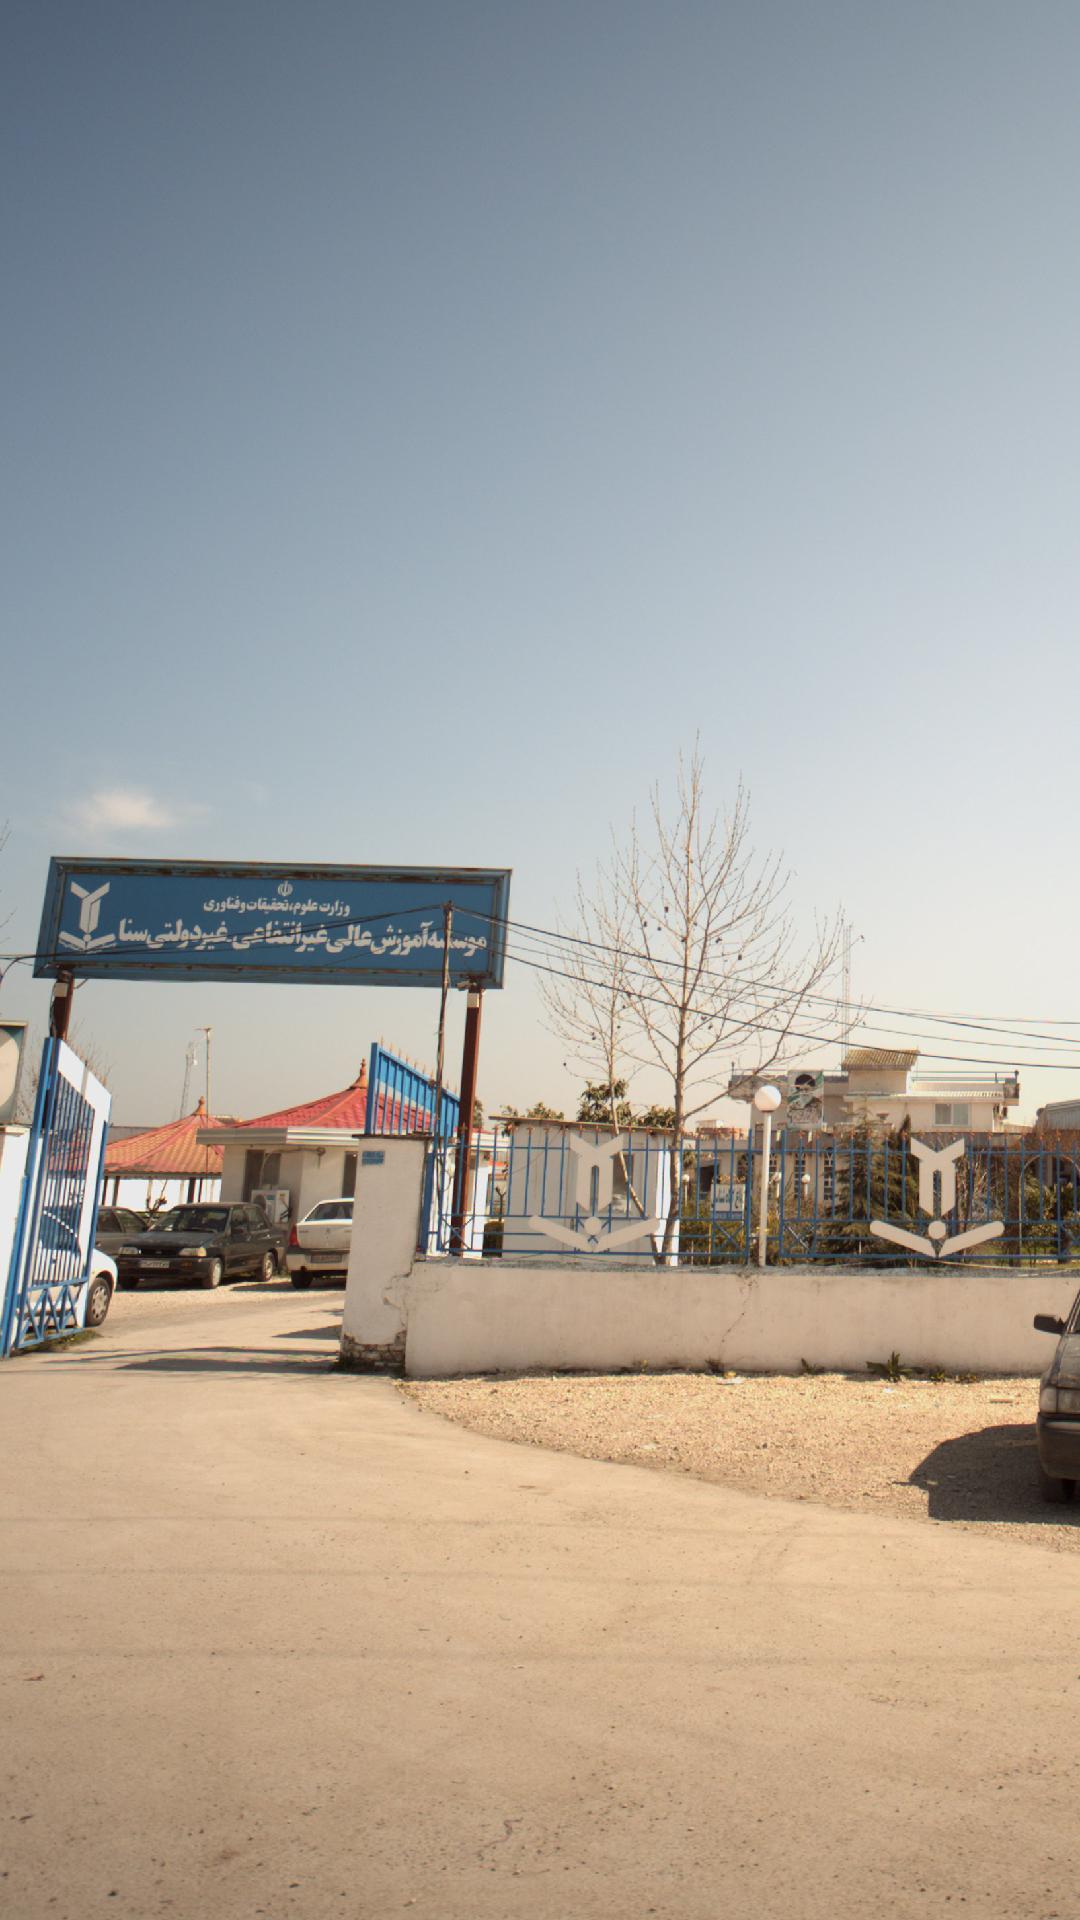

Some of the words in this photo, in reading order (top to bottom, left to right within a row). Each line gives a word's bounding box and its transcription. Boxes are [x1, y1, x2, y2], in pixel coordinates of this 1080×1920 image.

[203, 896, 240, 912] فناوری
[247, 897, 289, 914] تحقیقات
[319, 899, 350, 917] وزارت
[118, 918, 148, 942] سنا
[326, 924, 372, 953] عالی
[370, 921, 434, 956] آموزش
